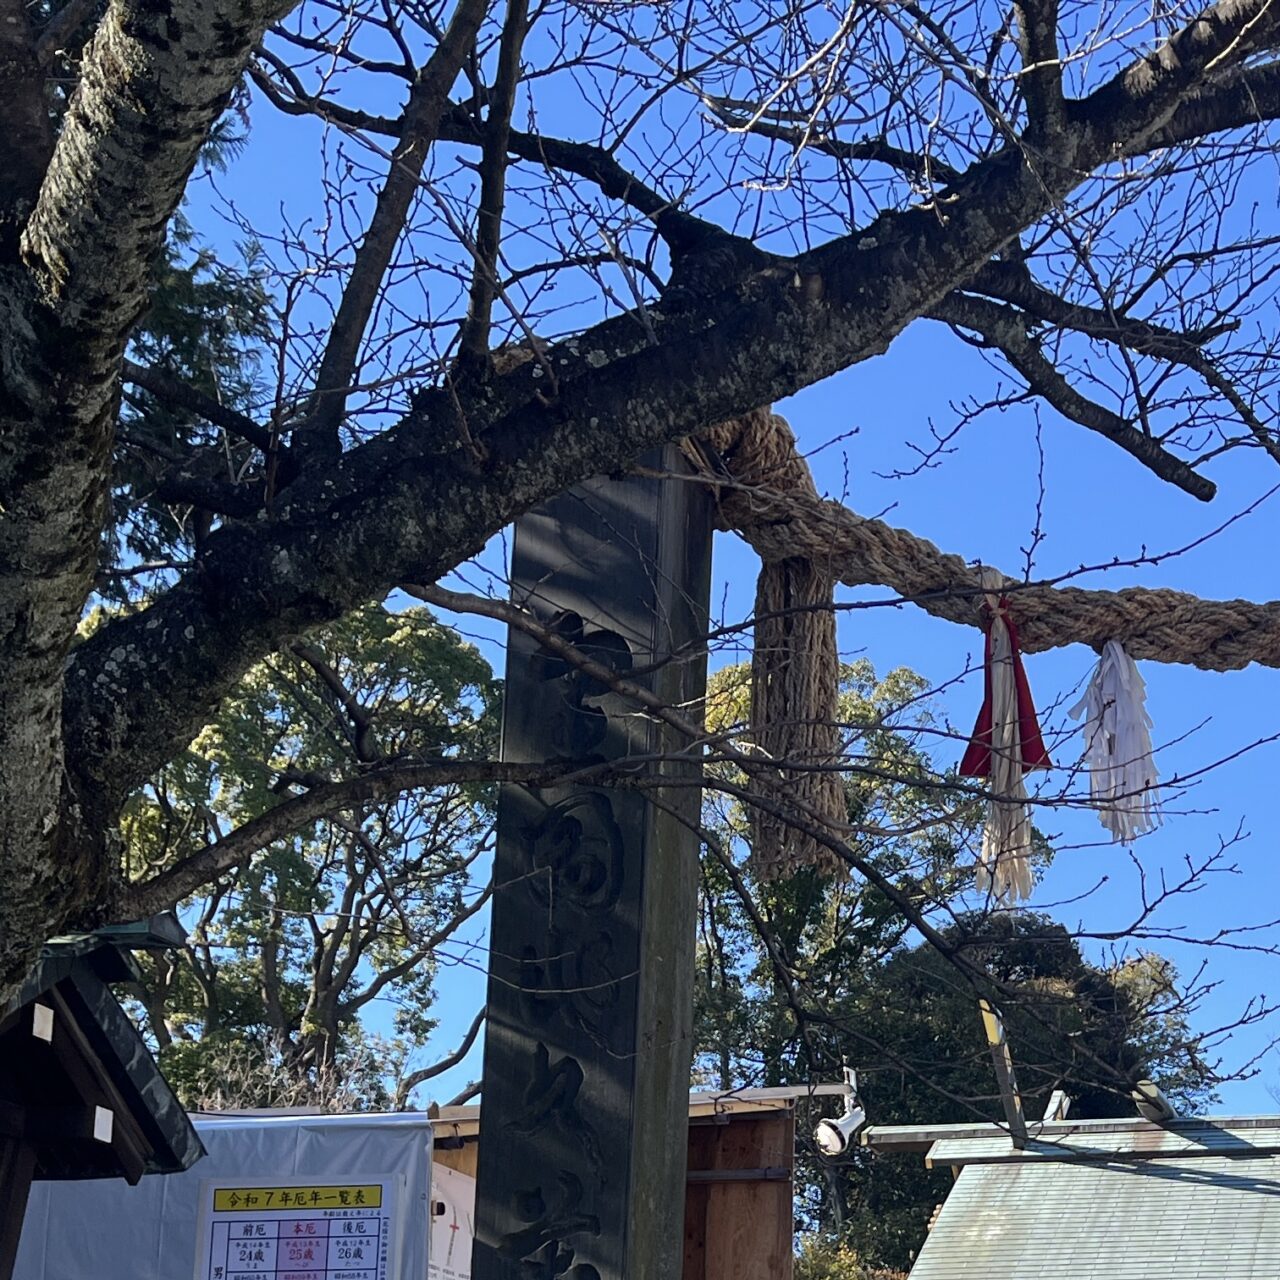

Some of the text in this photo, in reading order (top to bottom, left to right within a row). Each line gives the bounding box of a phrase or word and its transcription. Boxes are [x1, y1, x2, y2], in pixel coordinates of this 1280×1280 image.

[227, 1189, 365, 1207] 令和7年厄年一覧表
[243, 1224, 266, 1236] 前厄
[293, 1223, 317, 1235] 本厄
[342, 1221, 366, 1234] 後厄
[239, 1250, 265, 1262] 24歳
[289, 1249, 315, 1261] 25歳
[338, 1248, 364, 1260] 26歳
